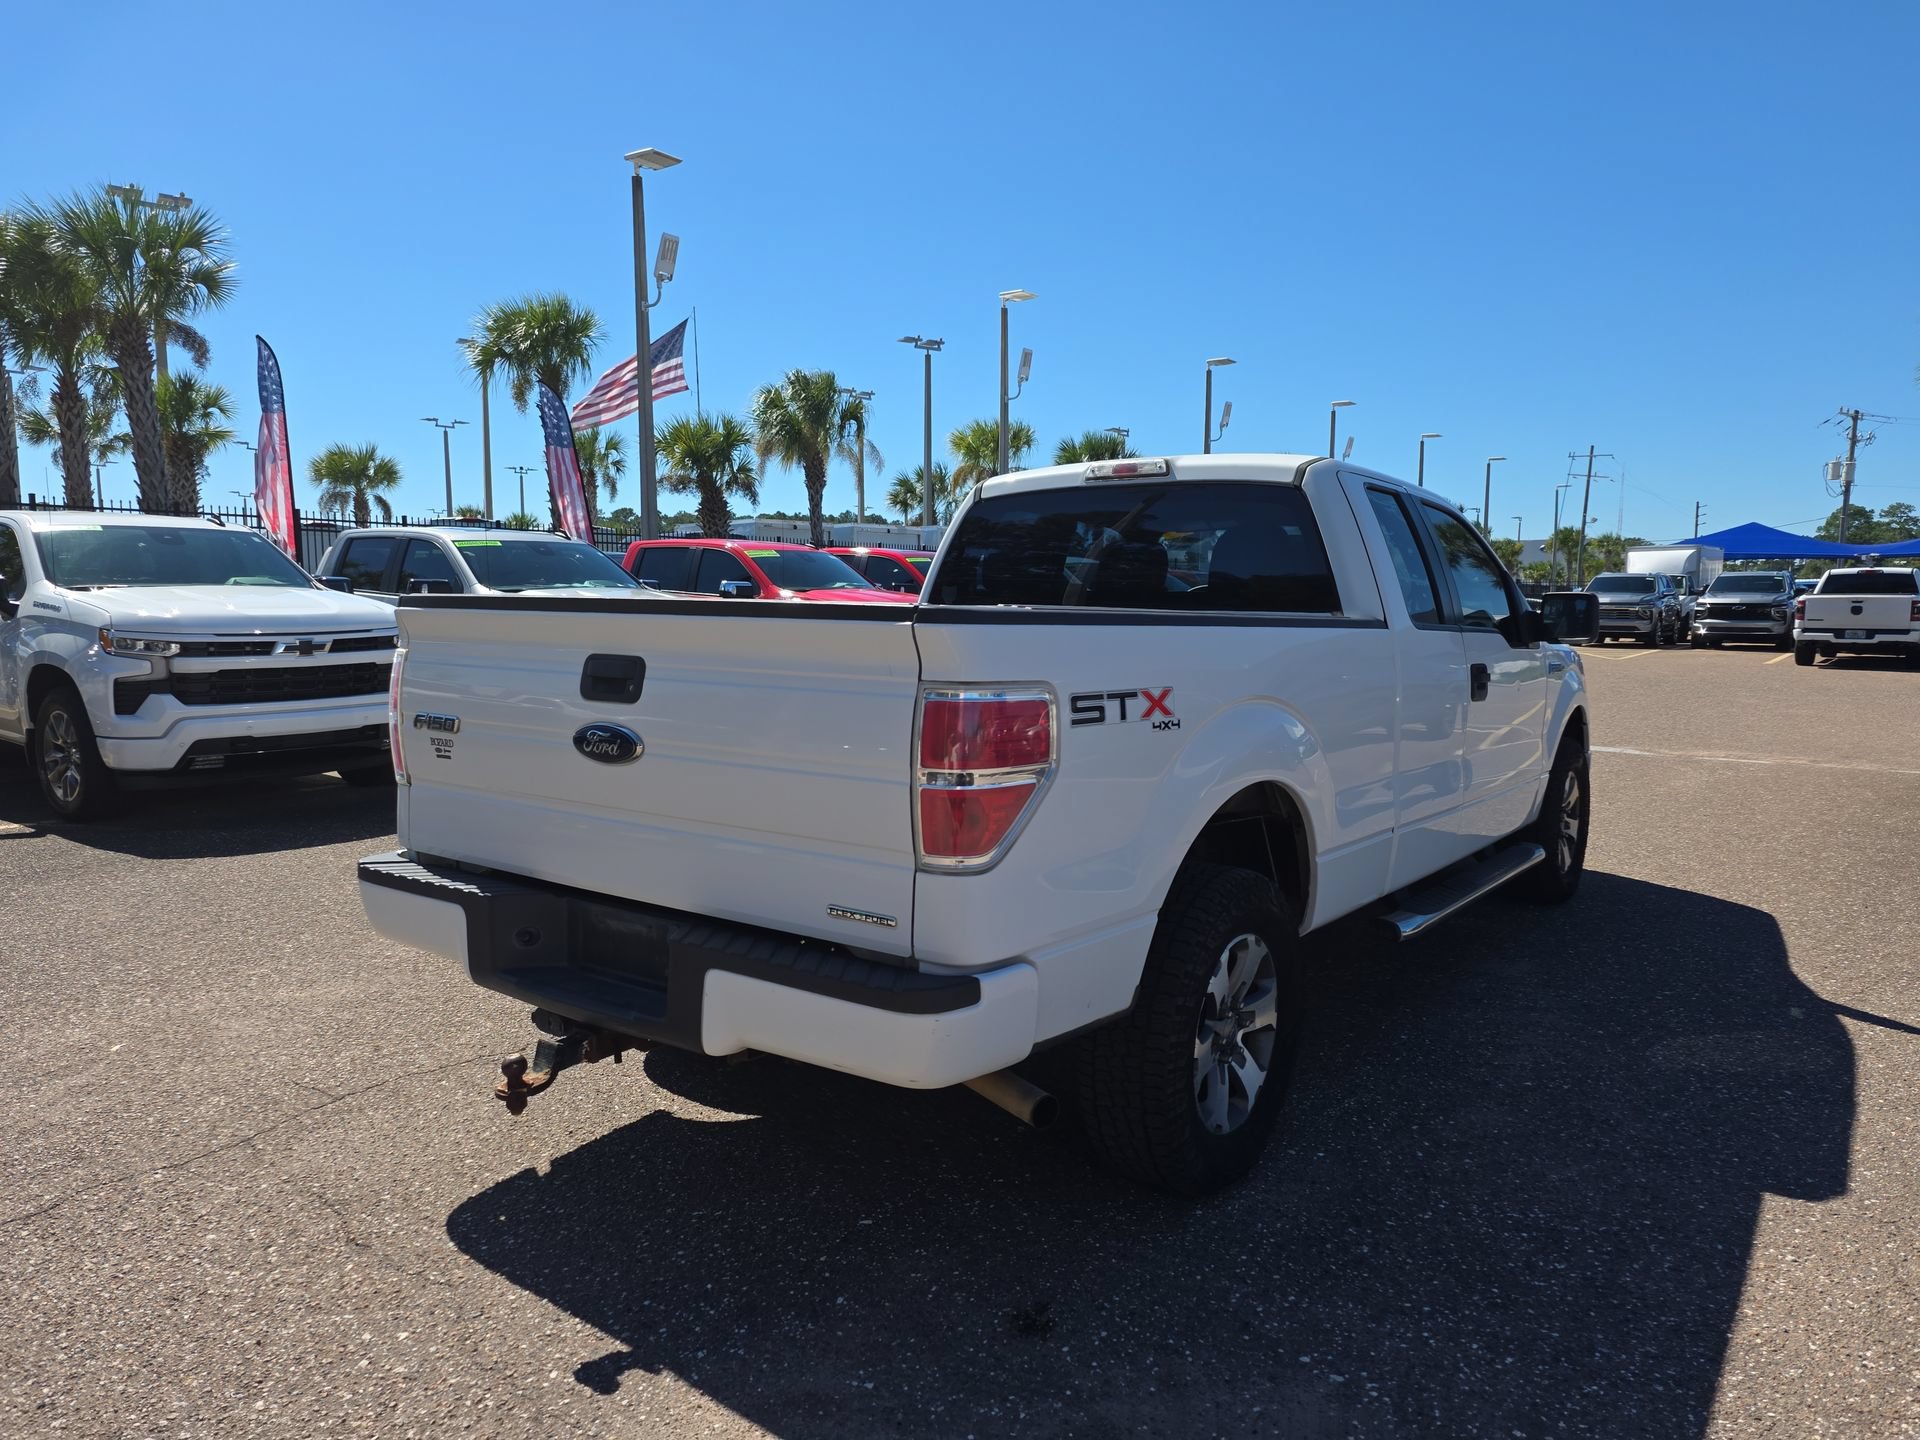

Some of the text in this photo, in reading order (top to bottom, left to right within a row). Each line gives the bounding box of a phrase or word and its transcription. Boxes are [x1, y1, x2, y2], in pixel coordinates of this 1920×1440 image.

[1070, 687, 1174, 726] STX
[583, 729, 621, 755] Ford
[864, 913, 897, 927] FUEL
